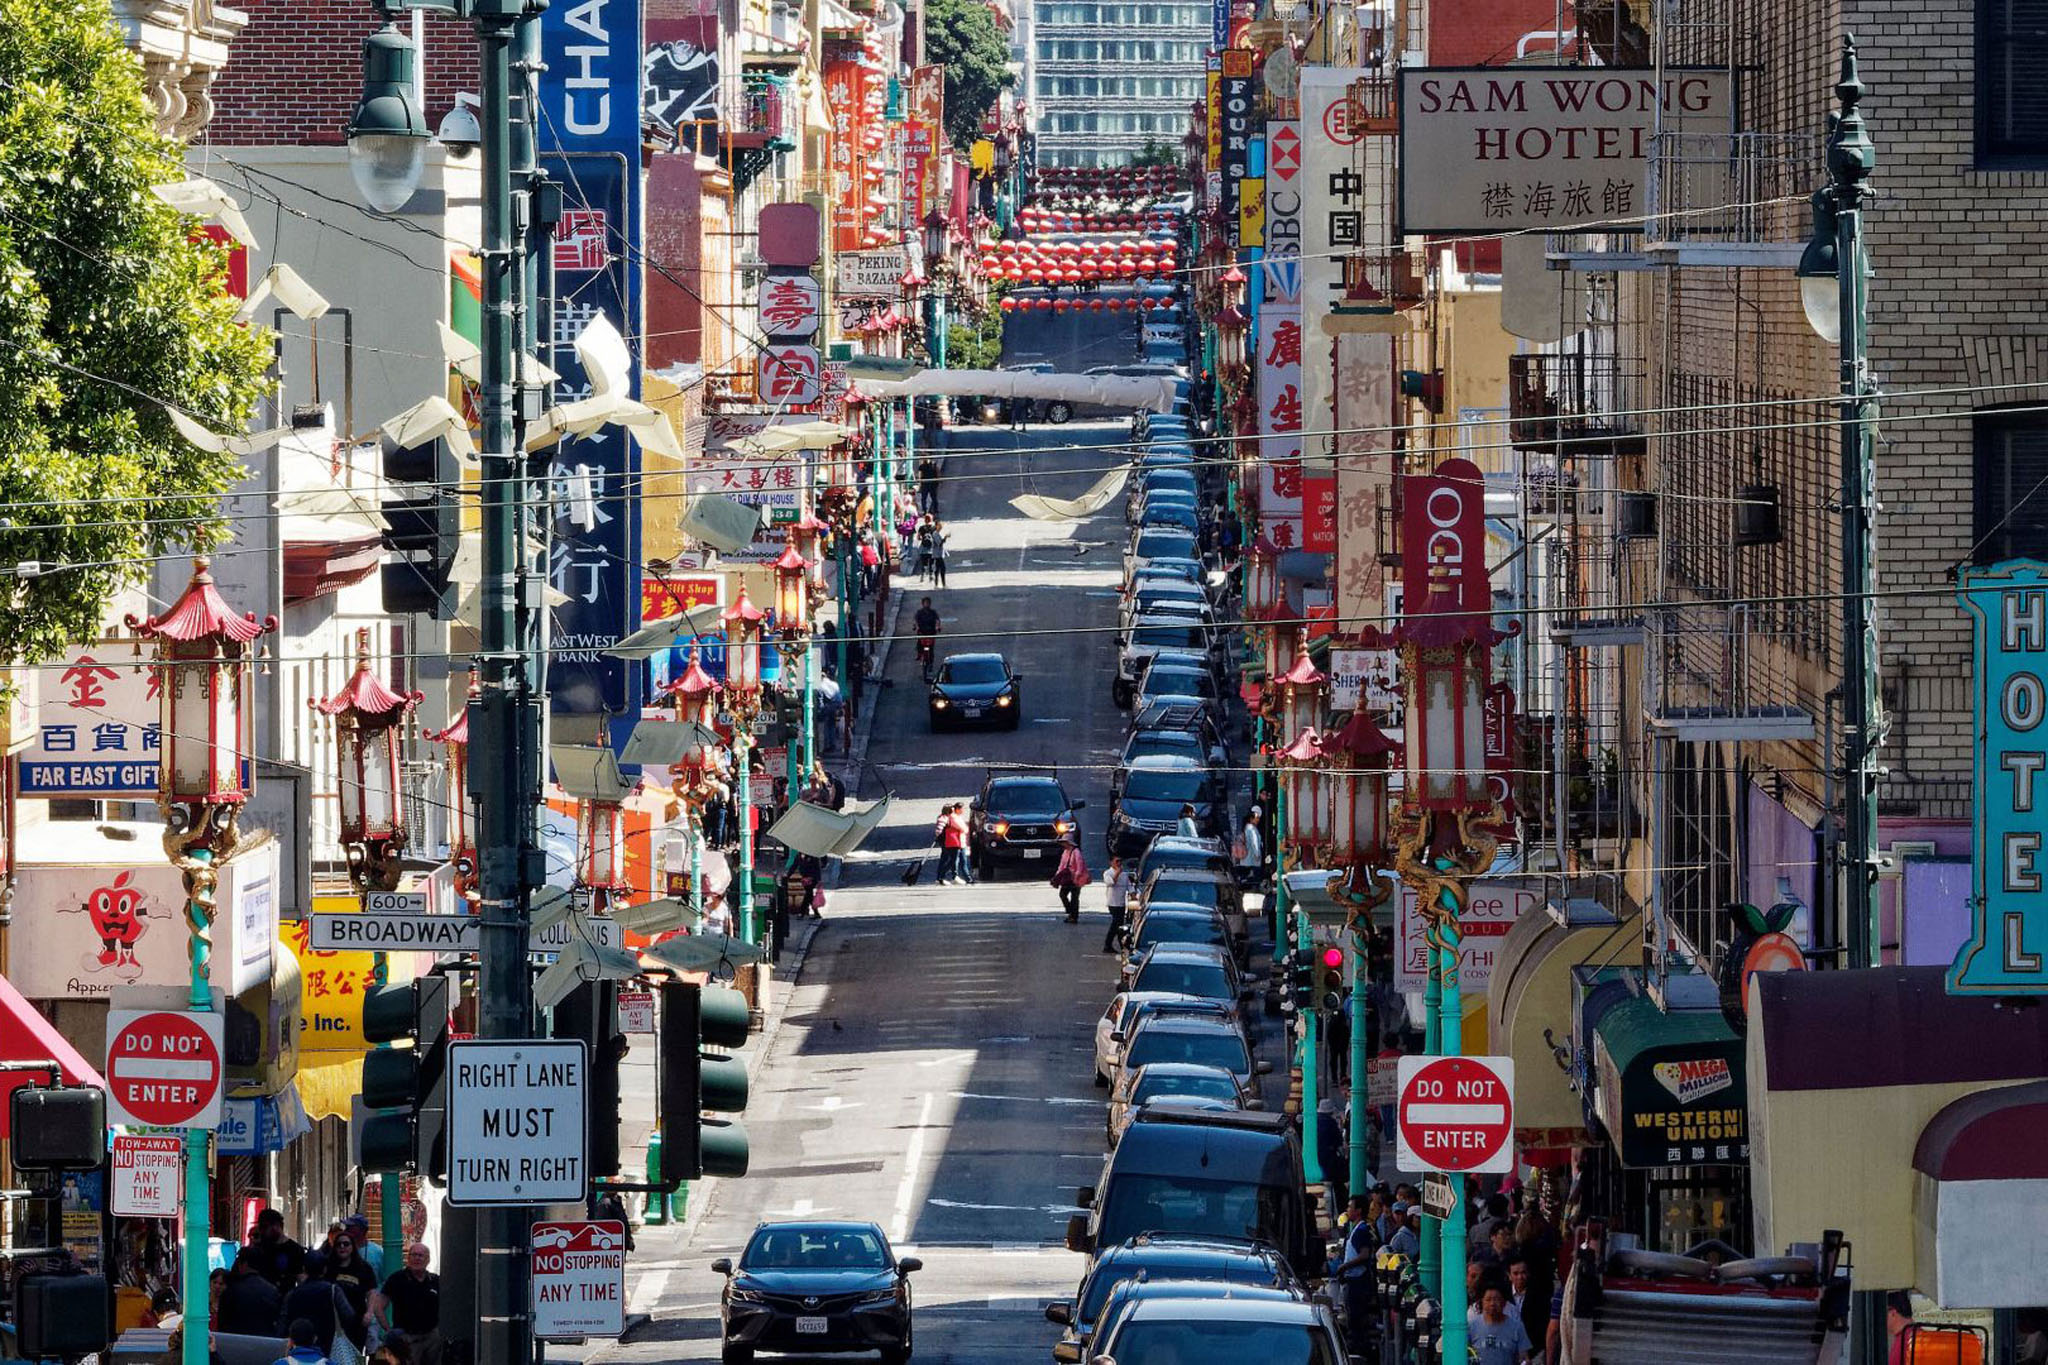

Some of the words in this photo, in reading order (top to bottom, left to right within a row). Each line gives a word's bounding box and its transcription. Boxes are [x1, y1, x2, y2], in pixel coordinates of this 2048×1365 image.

[1419, 80, 1528, 113] SAM
[1544, 79, 1713, 112] WONG
[1229, 80, 1247, 151] FOUR
[904, 156, 919, 227] BAKER
[858, 256, 901, 270] PEKING
[737, 493, 751, 505] DIM
[770, 493, 795, 505] HOUSE
[688, 583, 714, 595] Shop
[557, 649, 602, 664] BANK
[721, 713, 777, 724] JASON
[32, 765, 65, 786] FAR
[71, 765, 117, 786] EAST
[2000, 592, 2046, 973] HOTEL
[372, 895, 408, 909] 600
[331, 919, 468, 944] BROADWAY
[315, 1013, 351, 1032] Inc.
[629, 1011, 642, 1019] ANY
[629, 1018, 644, 1027] TIME
[125, 1034, 153, 1052] DO
[162, 1035, 203, 1053] NOT
[459, 1063, 518, 1088] RIGHT
[526, 1063, 577, 1087] LANE
[1678, 1058, 1728, 1083] MEGA
[1416, 1079, 1443, 1098] DO
[1457, 1080, 1496, 1098] NOT
[1678, 1072, 1729, 1095] MILLIONS
[128, 1084, 198, 1103] ENTER
[483, 1107, 555, 1138] MUST
[1634, 1109, 1738, 1128] WESTERN
[1423, 1130, 1486, 1149] ENTER
[1667, 1124, 1738, 1142] UNION
[120, 1138, 176, 1149] TOW-AWAY
[115, 1149, 133, 1168] NO
[135, 1153, 177, 1168] STOPPING
[134, 1171, 159, 1184] ANY
[457, 1159, 510, 1182] TURN
[521, 1157, 578, 1182] RIGHT
[132, 1186, 161, 1200] TIME
[536, 1254, 562, 1271] NO
[565, 1254, 620, 1270] STOPPING
[540, 1283, 573, 1302] ANY
[580, 1282, 618, 1302] TIME
